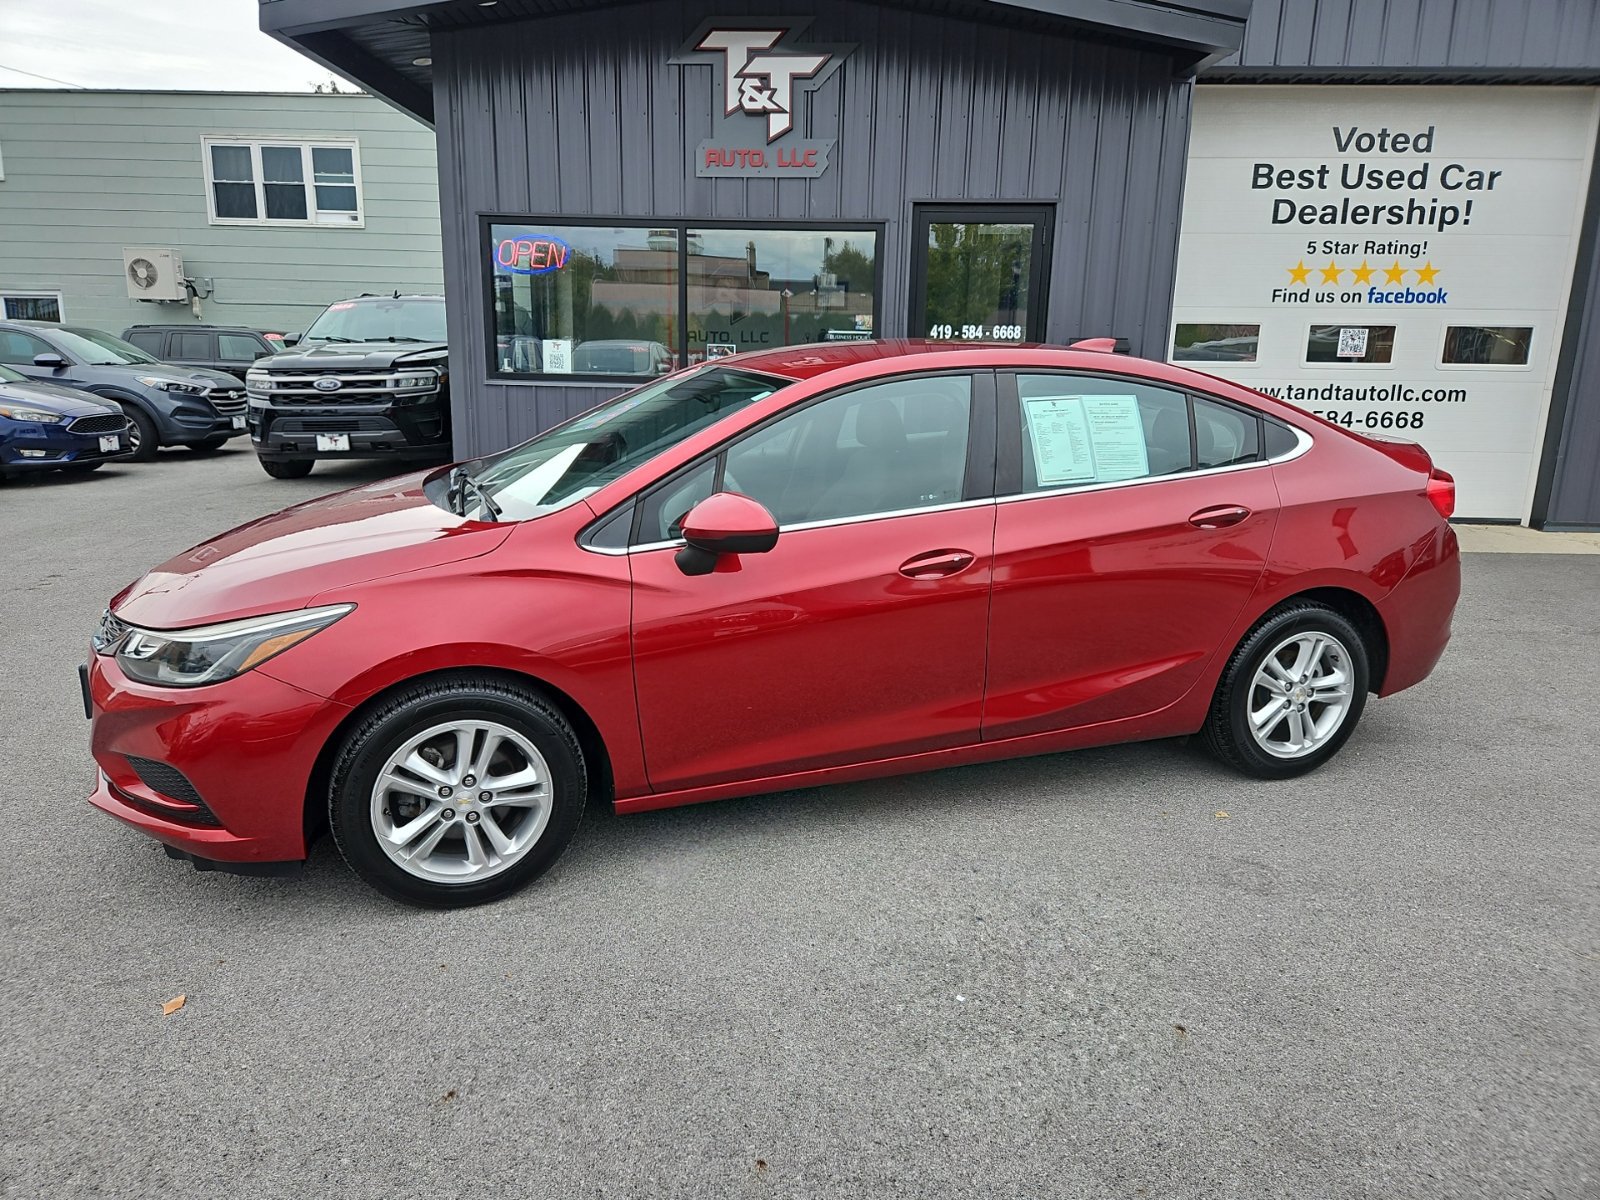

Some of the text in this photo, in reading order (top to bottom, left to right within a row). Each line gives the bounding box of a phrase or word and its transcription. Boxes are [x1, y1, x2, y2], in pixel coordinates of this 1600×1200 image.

[694, 28, 832, 144] T&T
[1332, 125, 1435, 153] Voted
[705, 149, 817, 168] AUTO, LLC
[1251, 162, 1503, 191] Best Used Car
[1271, 197, 1474, 232] Dealership!
[498, 239, 566, 269] OPEN
[1306, 240, 1429, 258] 5 Star Rating!
[1271, 287, 1448, 304] Find us on facebook
[740, 331, 769, 344] LLC
[930, 324, 952, 339] 419
[961, 324, 983, 339] 584
[992, 325, 1021, 339] 6668
[1253, 384, 1467, 402] w.tandtautollc.com
[1312, 410, 1425, 429] 84-6668
